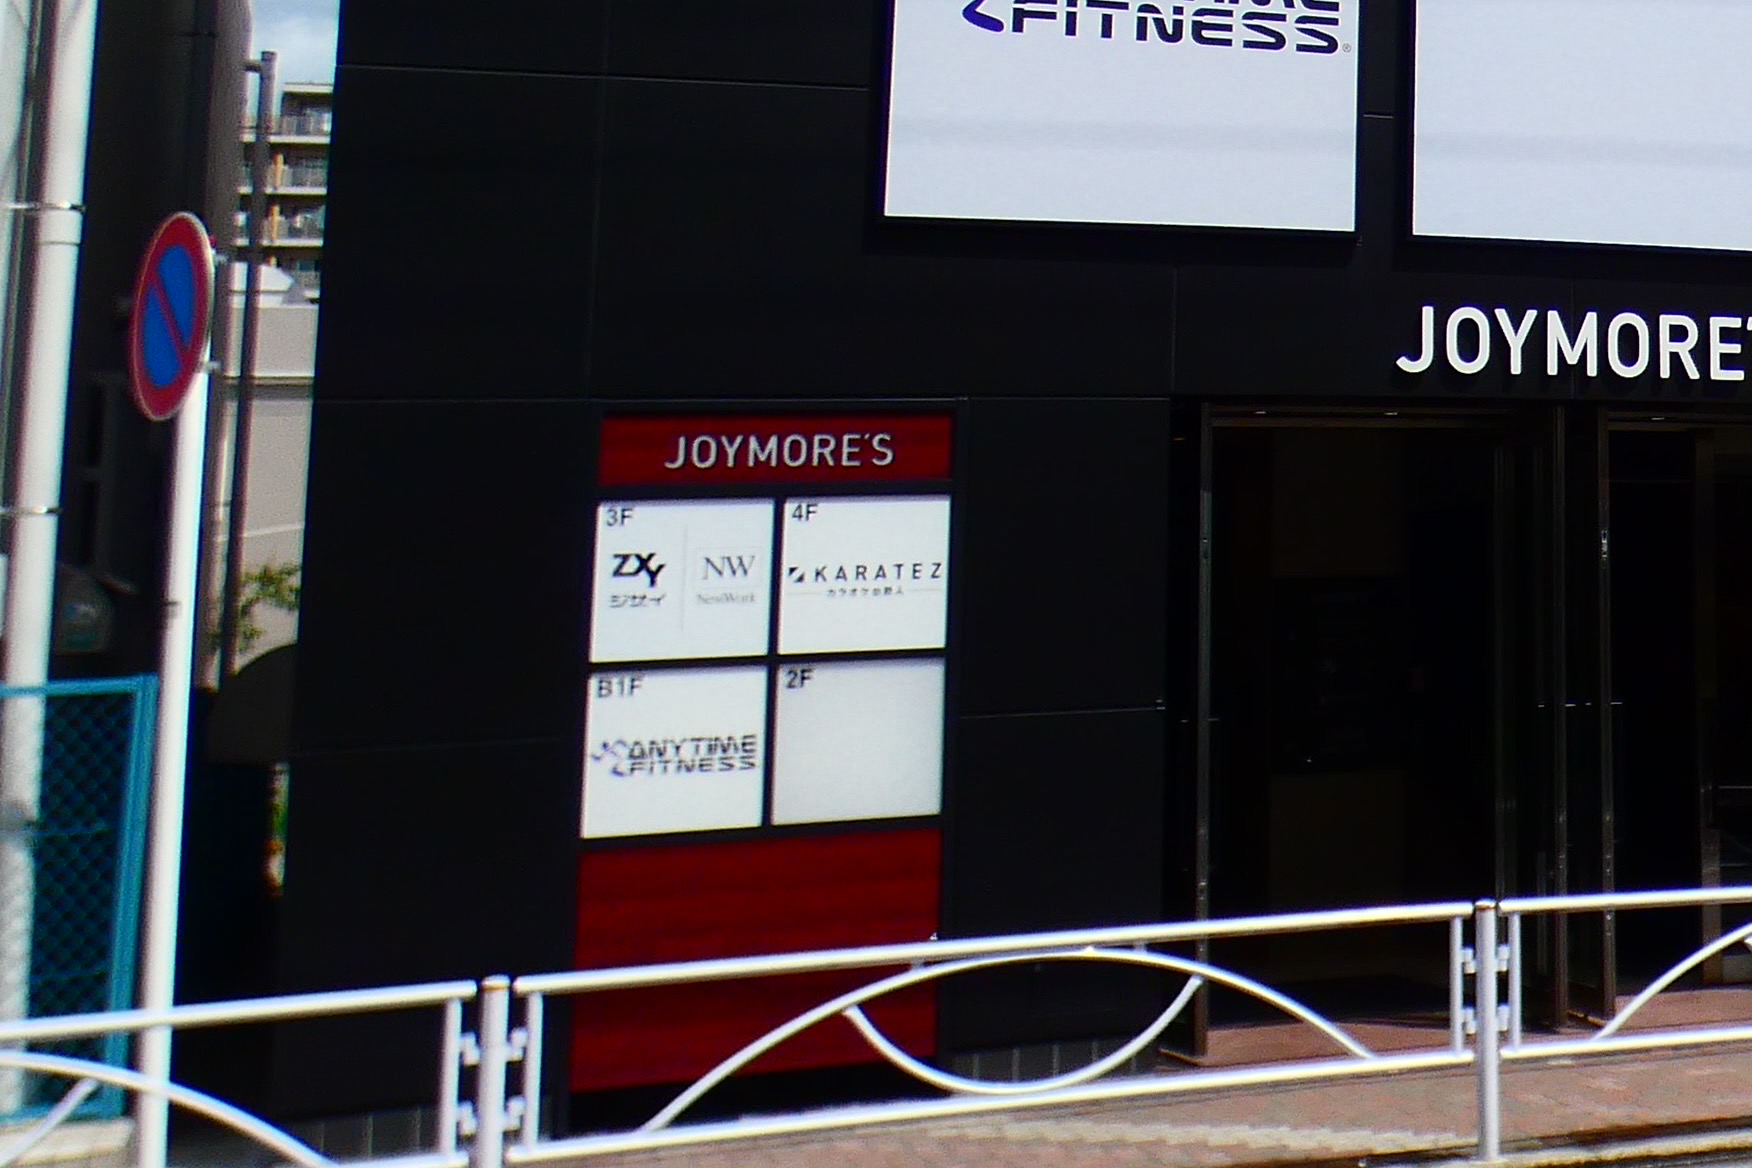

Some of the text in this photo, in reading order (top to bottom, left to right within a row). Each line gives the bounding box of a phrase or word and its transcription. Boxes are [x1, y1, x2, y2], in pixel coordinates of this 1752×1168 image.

[664, 432, 895, 470] JOYMORE'S
[605, 507, 635, 527] 3F
[791, 503, 819, 522] 4F
[611, 552, 667, 588] ZXY
[702, 554, 756, 581] NW
[813, 561, 943, 582] KARATEZ
[598, 673, 643, 698] B1F
[784, 668, 816, 690] 2F
[627, 734, 758, 760] ANYTIME
[627, 756, 757, 776] FITNESS
